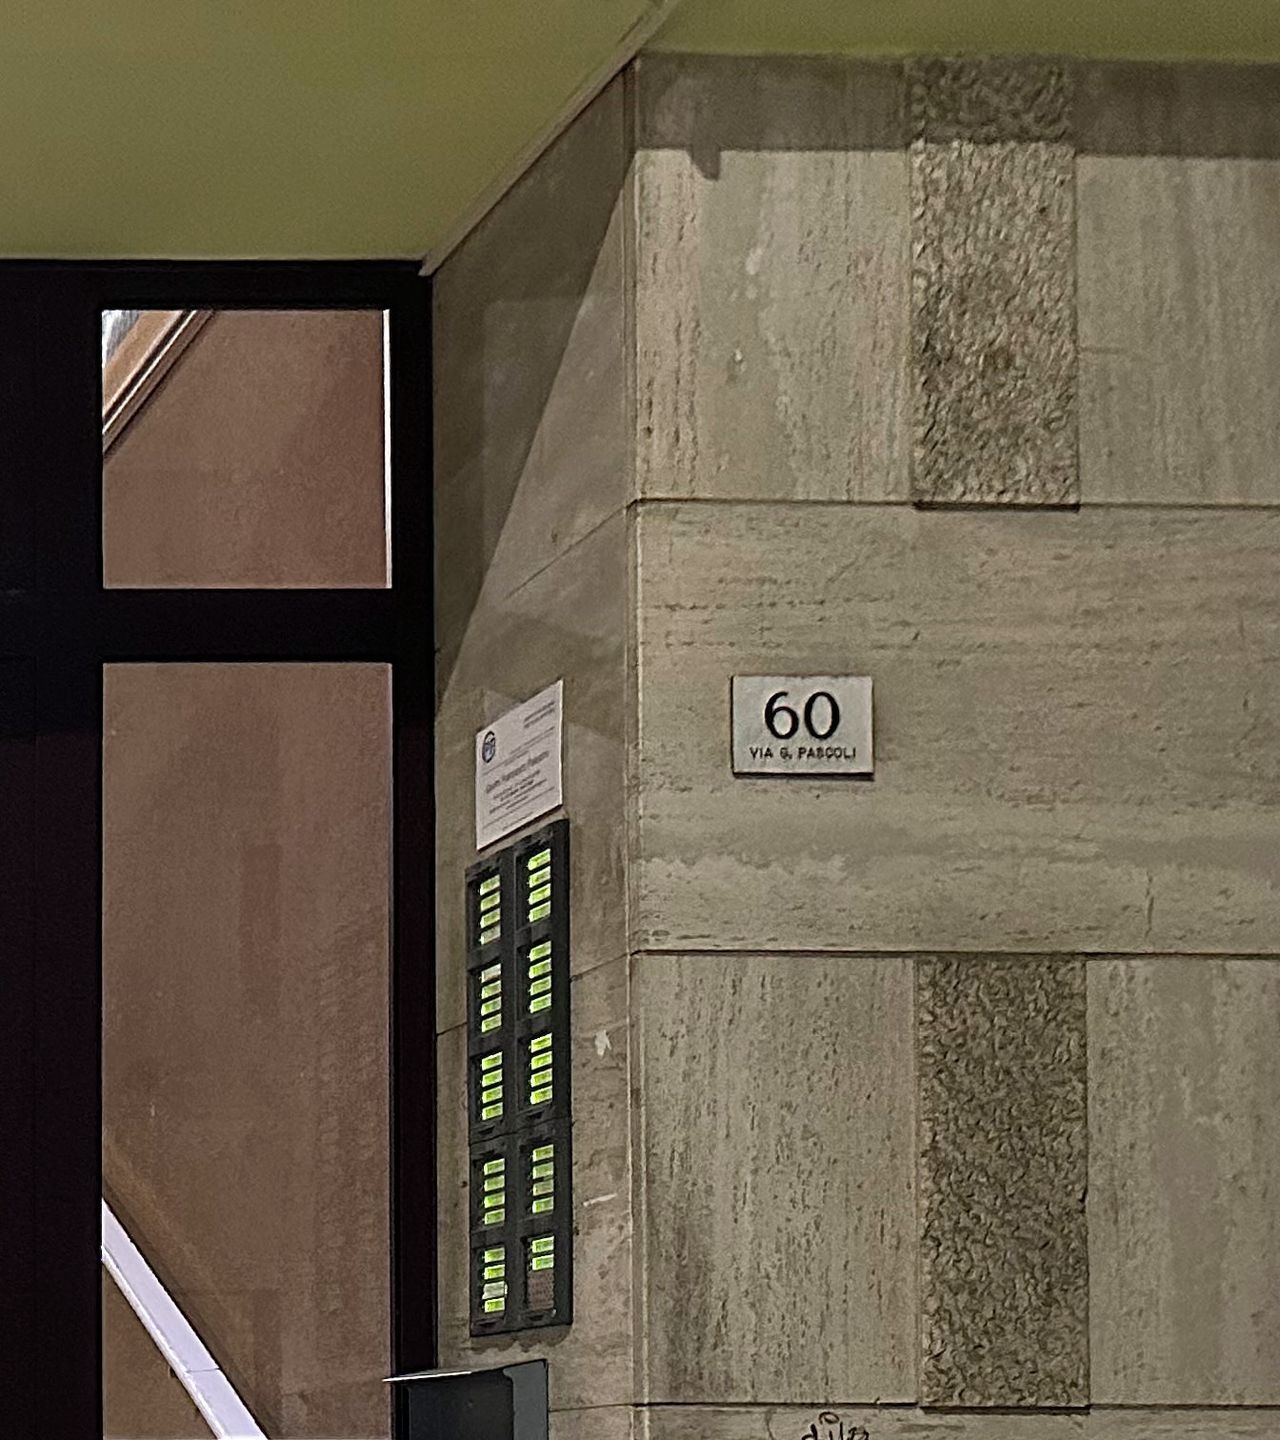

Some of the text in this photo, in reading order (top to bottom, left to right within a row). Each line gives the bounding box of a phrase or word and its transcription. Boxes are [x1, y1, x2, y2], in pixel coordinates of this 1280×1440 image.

[764, 691, 841, 741] 60
[749, 747, 773, 760] VIA
[797, 746, 856, 760] PASCOLI
